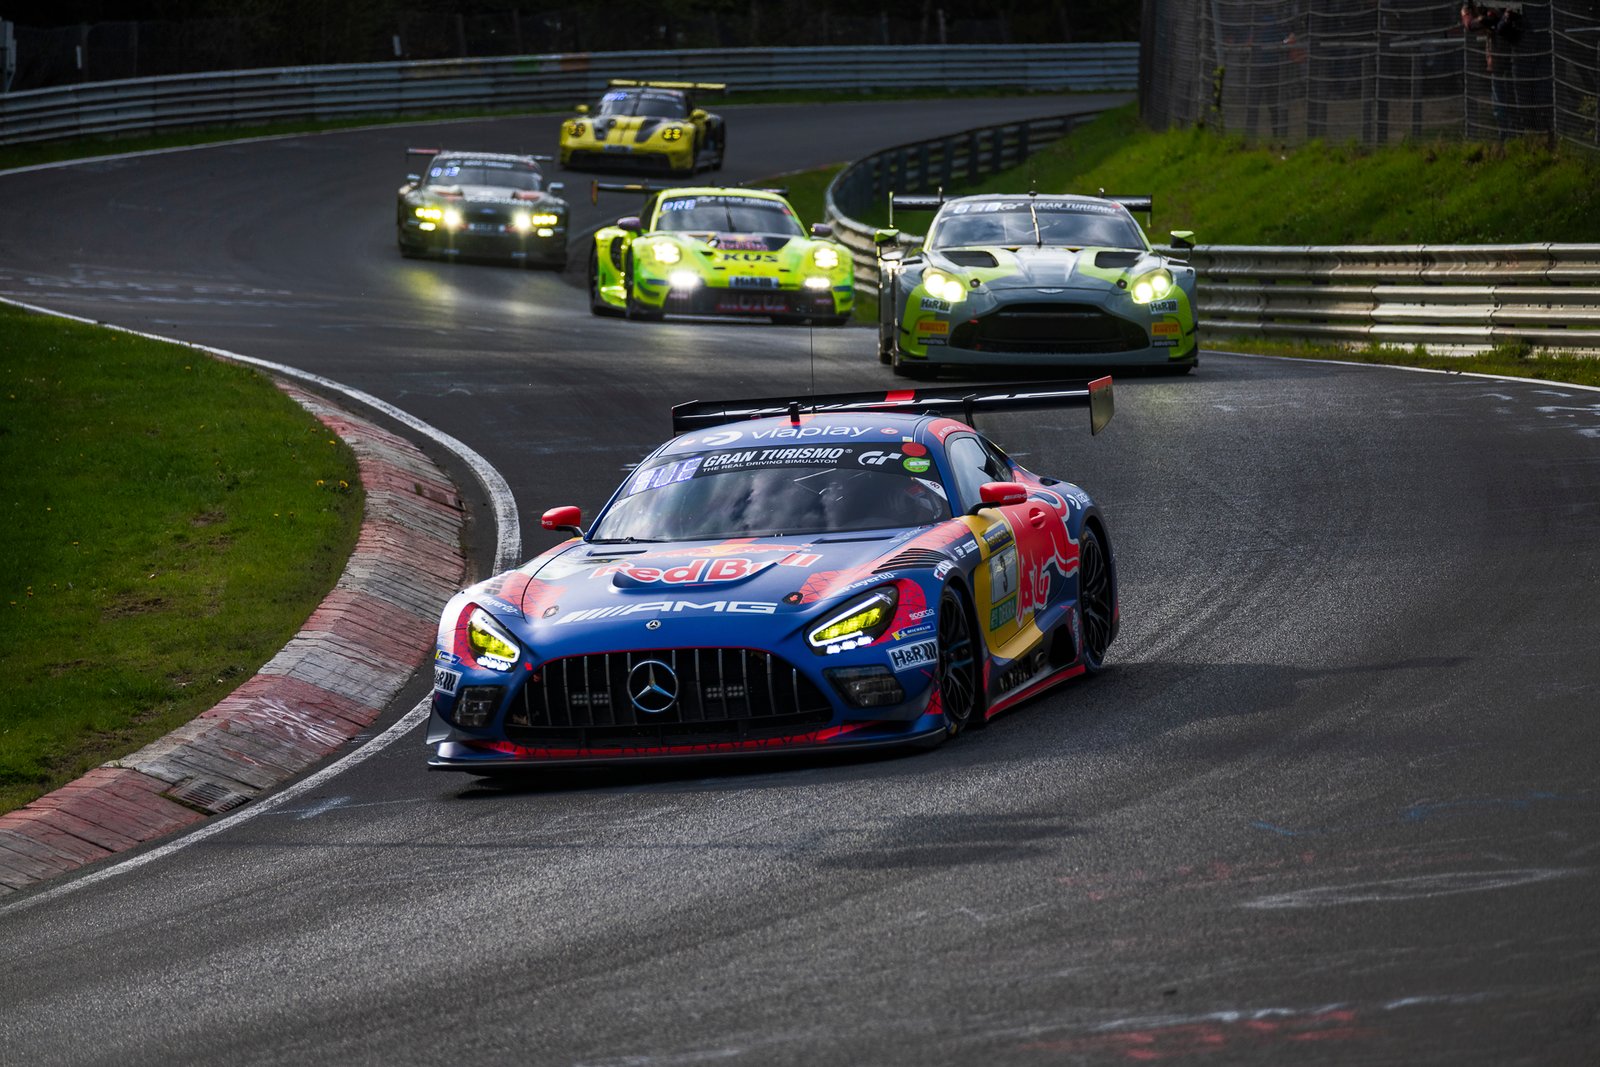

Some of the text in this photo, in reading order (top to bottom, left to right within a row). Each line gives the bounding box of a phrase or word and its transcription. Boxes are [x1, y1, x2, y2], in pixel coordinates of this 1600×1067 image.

[1065, 203, 1117, 213] TURISMO
[723, 253, 779, 263] KUS
[752, 425, 874, 440] viaplay
[703, 448, 845, 468] GRAN TURISMO
[702, 465, 721, 473] THE
[721, 463, 744, 471] REAL
[745, 460, 783, 468] DRIVING
[588, 558, 711, 584] Red
[621, 600, 779, 616] AMG
[890, 643, 927, 668] H&R
